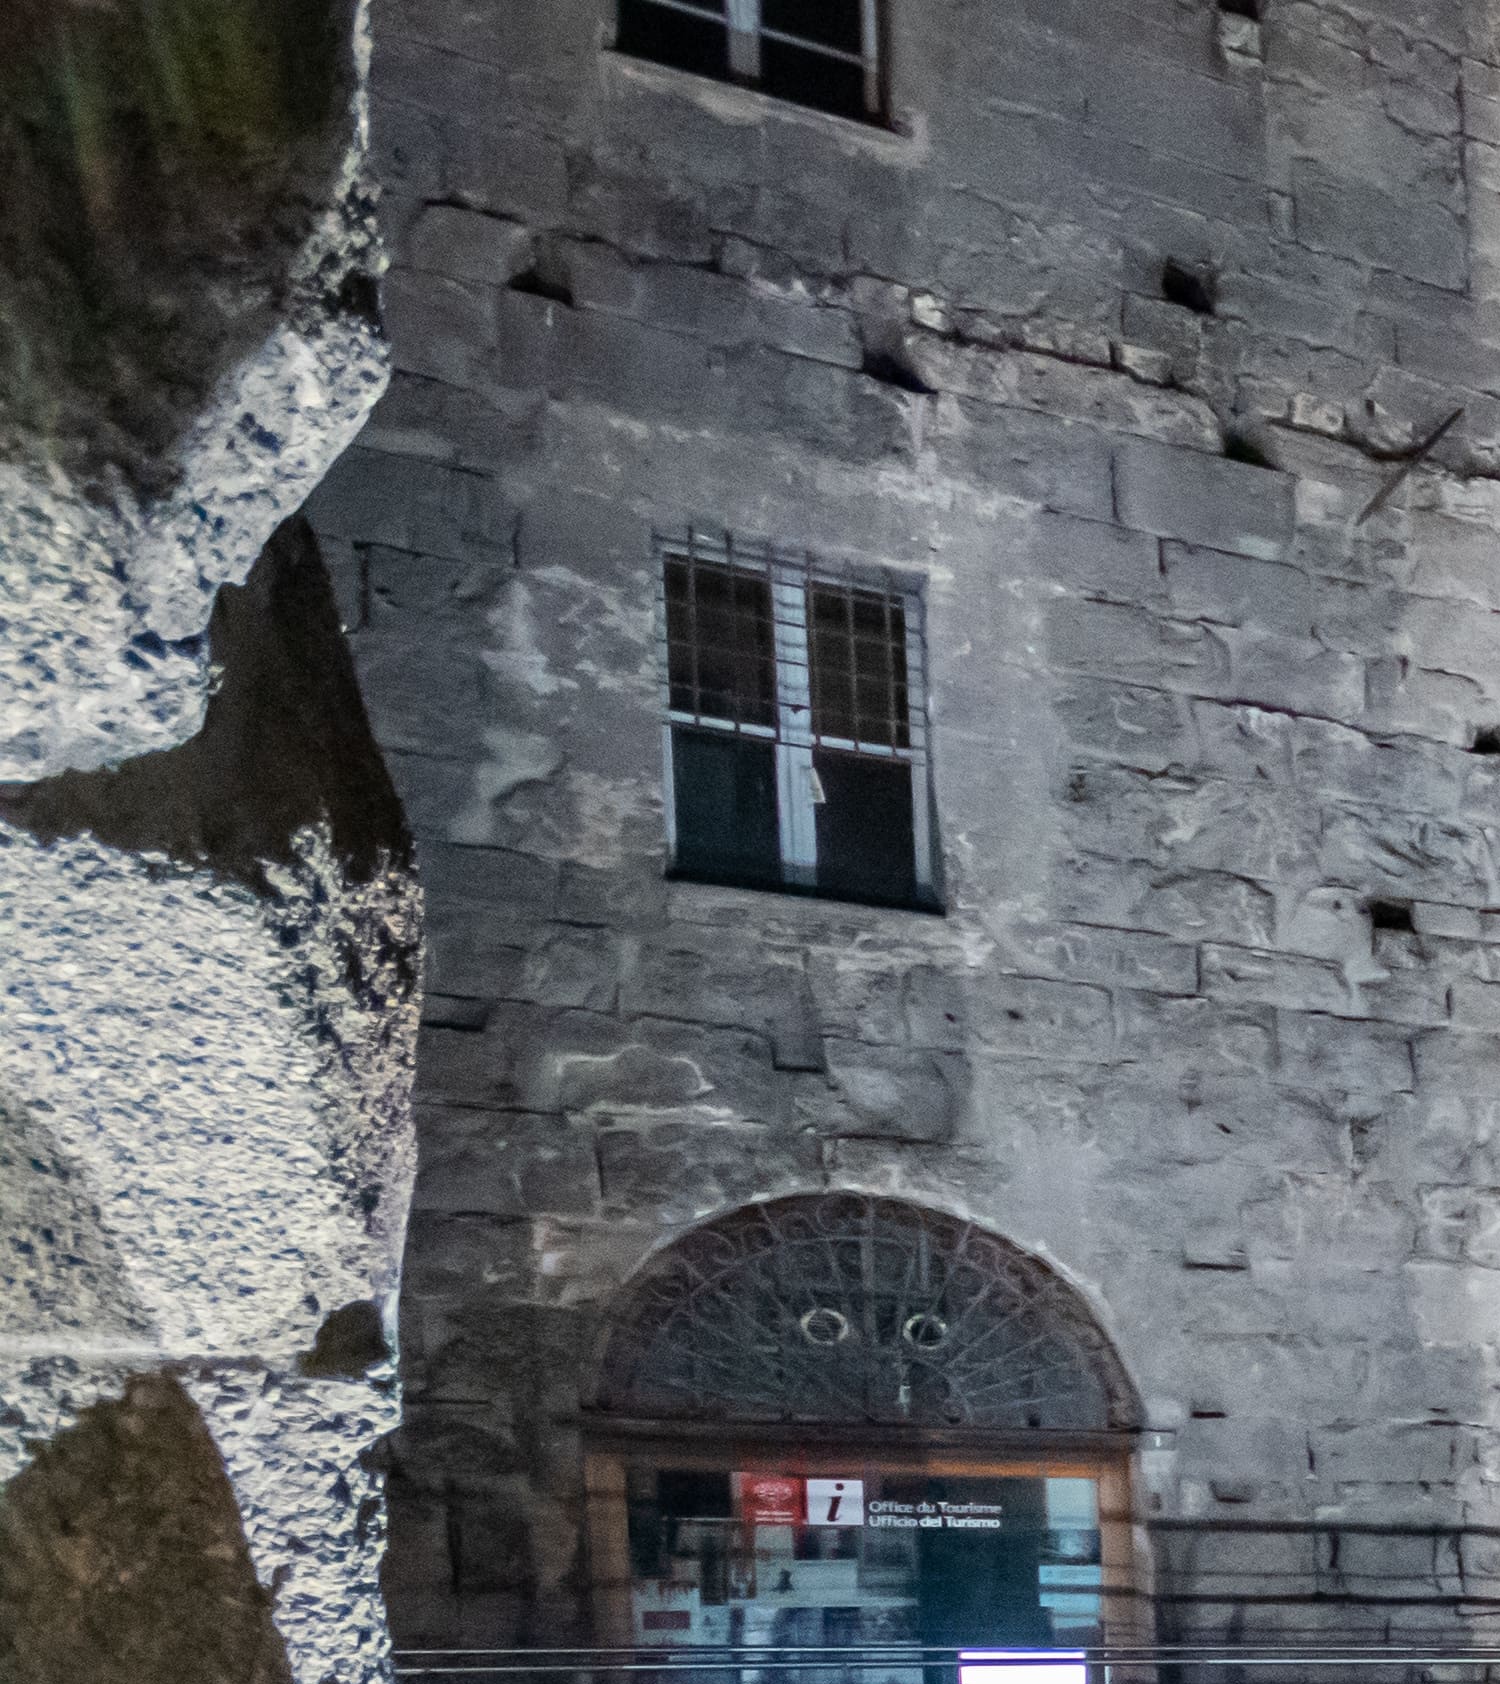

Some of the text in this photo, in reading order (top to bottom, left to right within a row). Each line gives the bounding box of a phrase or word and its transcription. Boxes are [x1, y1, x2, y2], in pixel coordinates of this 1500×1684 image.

[827, 1482, 845, 1522] i
[869, 1501, 1002, 1514] Office du Tourisme
[869, 1515, 1001, 1528] Ufficio del Turismo
